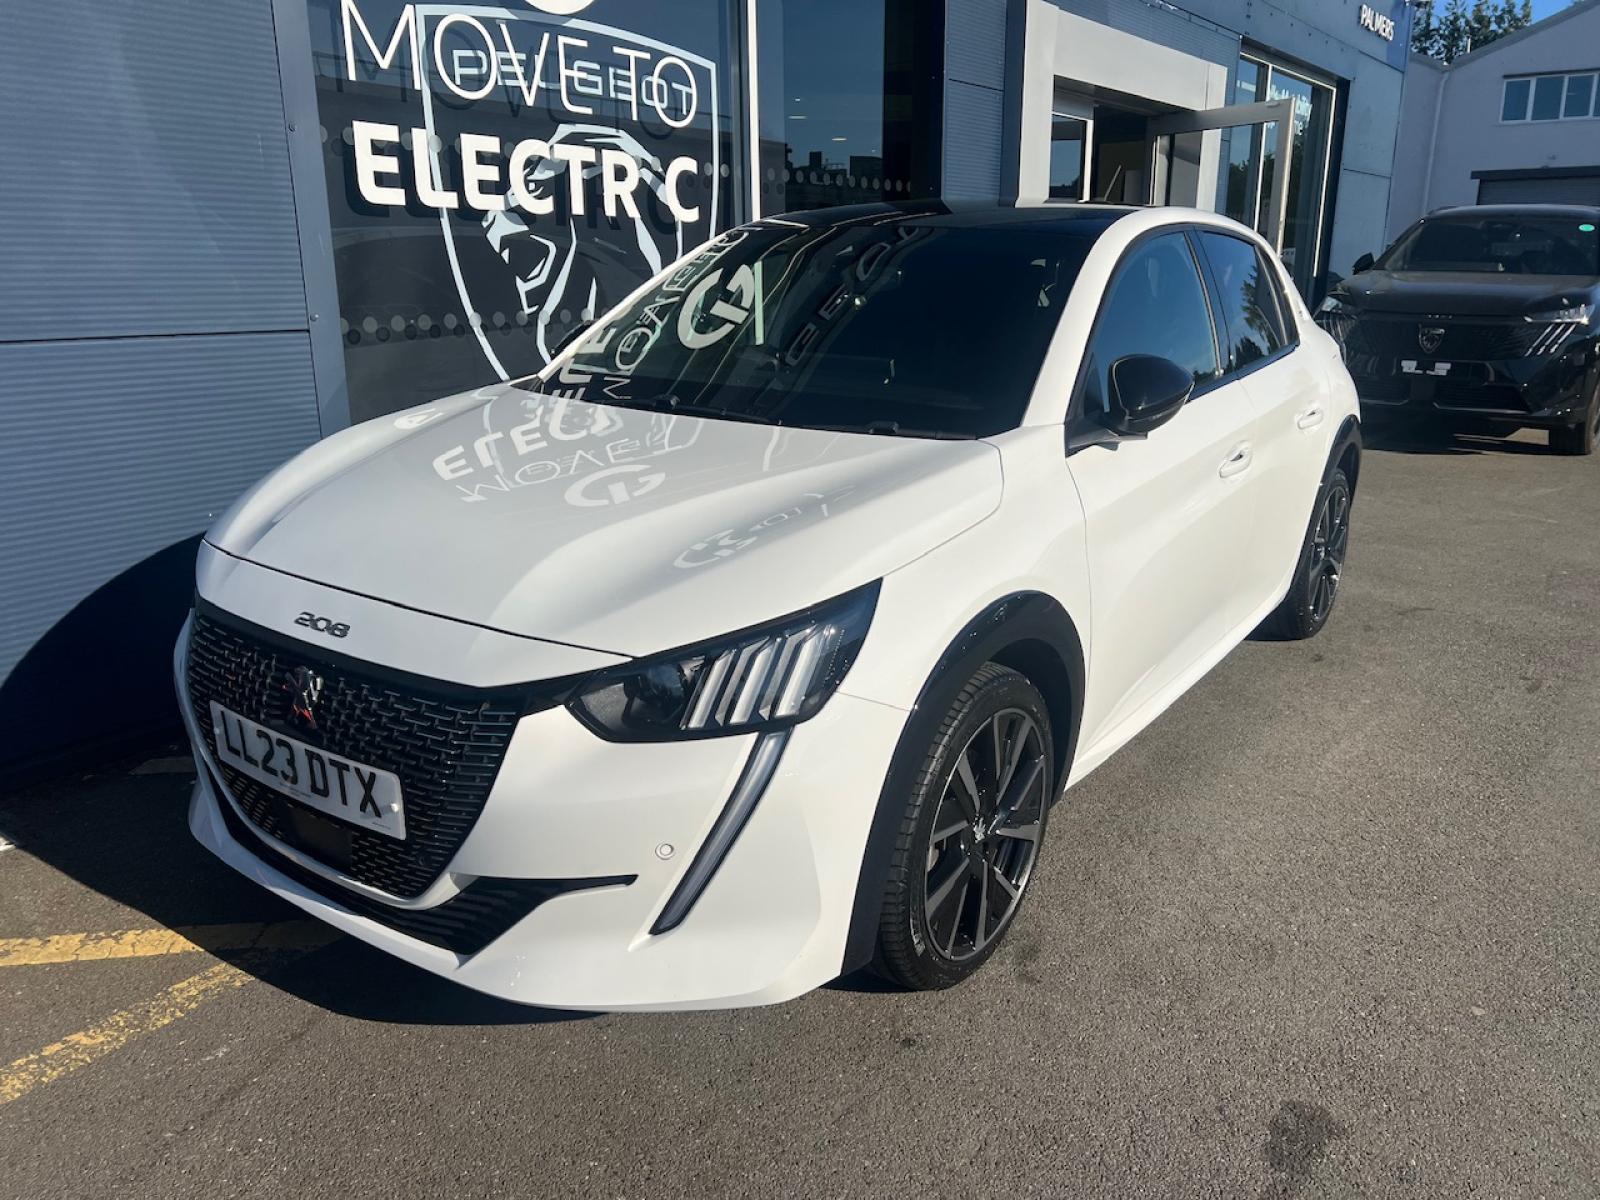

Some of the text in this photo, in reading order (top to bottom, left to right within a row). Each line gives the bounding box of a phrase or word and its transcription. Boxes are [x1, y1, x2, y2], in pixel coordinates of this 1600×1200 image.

[341, 0, 697, 128] MOVE TO
[1360, 4, 1395, 41] PALMERS
[352, 120, 700, 223] ELECTRC
[294, 611, 350, 638] 208
[220, 710, 382, 819] LL23 DTX
